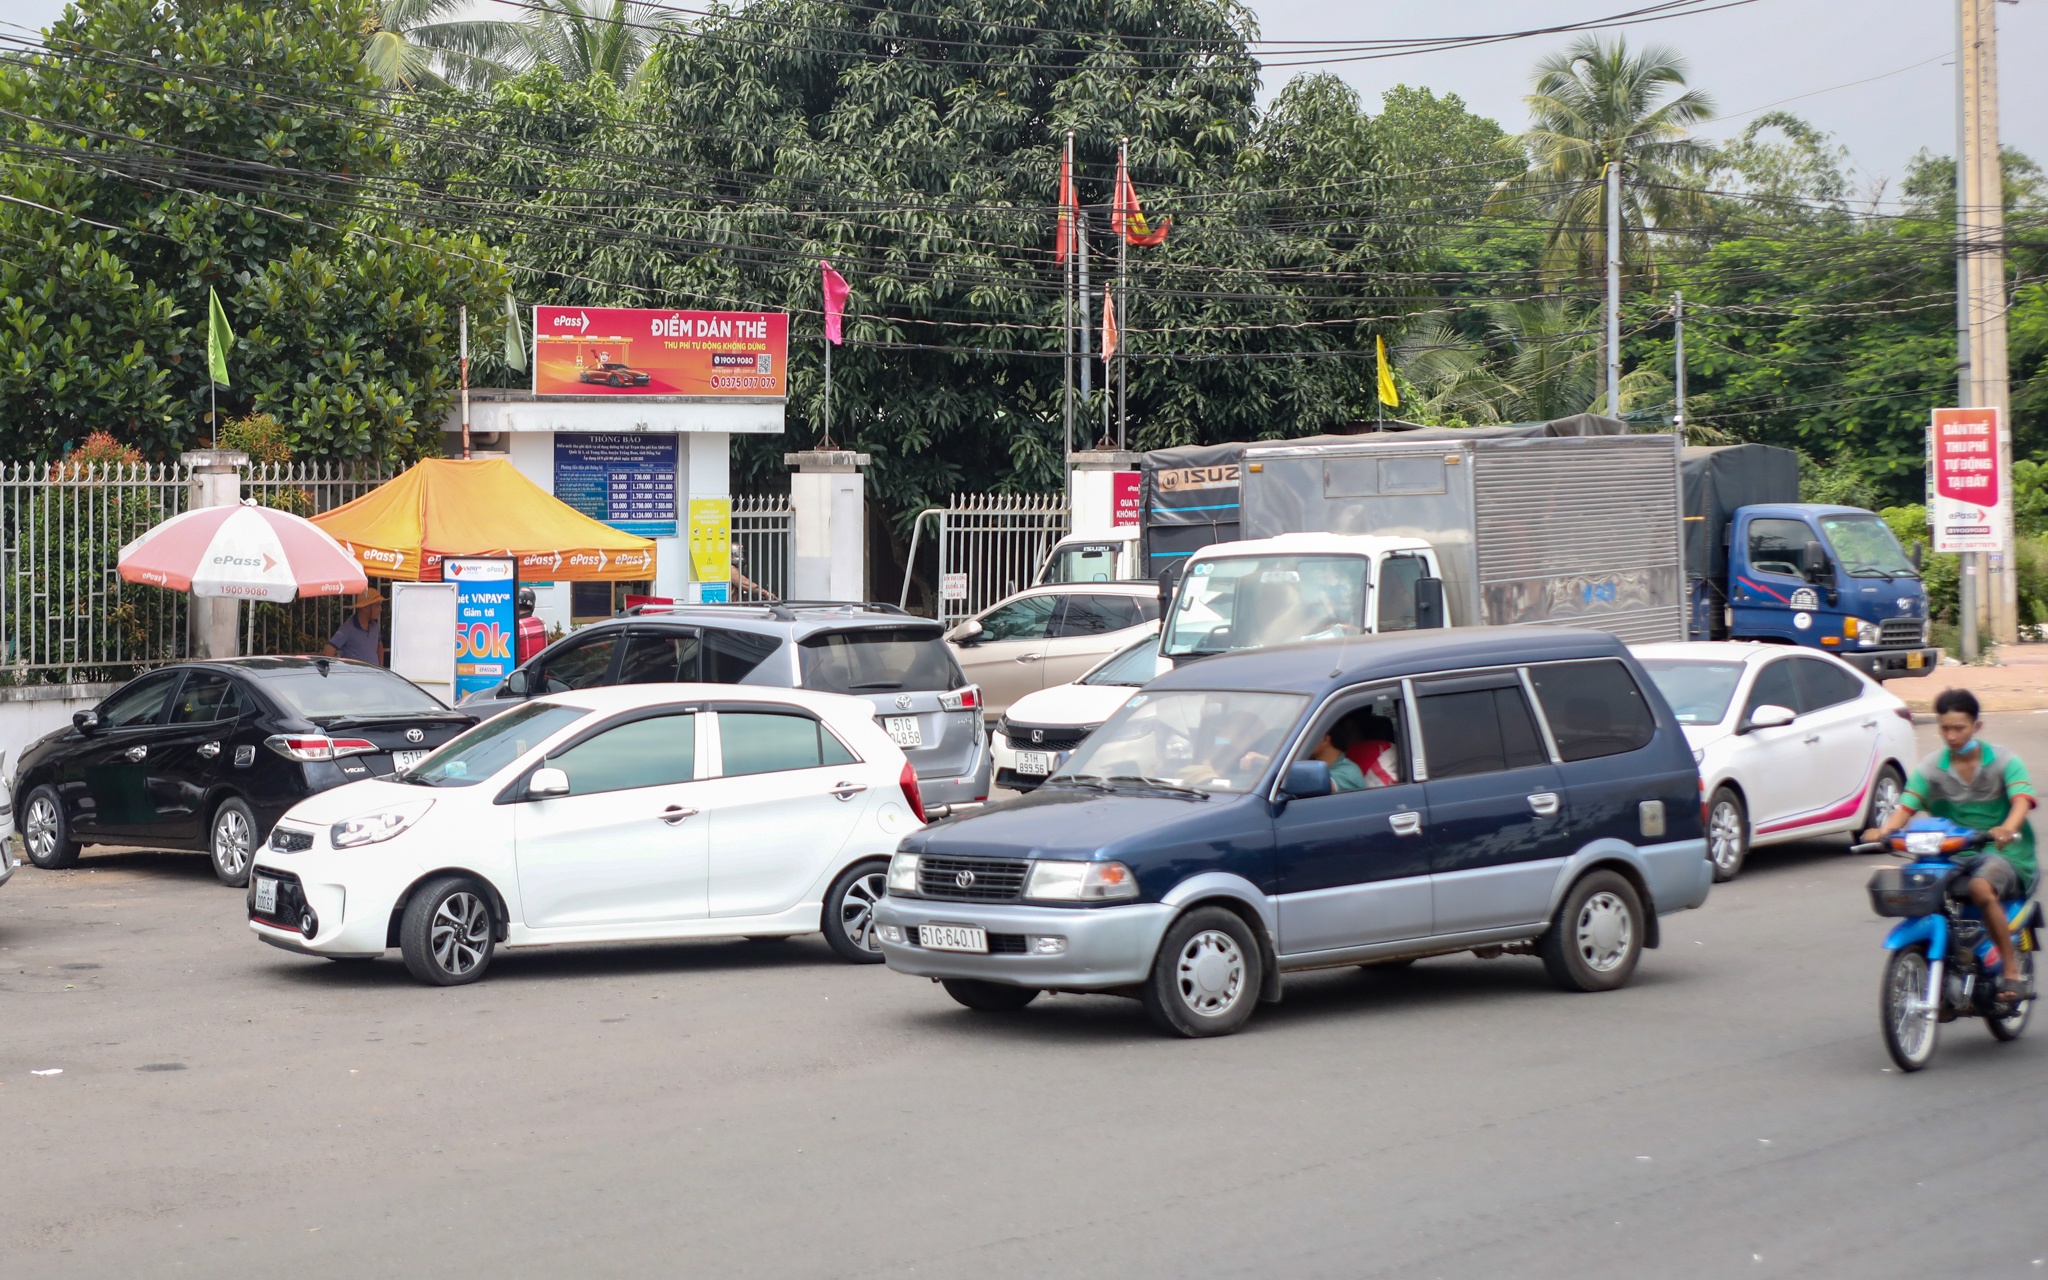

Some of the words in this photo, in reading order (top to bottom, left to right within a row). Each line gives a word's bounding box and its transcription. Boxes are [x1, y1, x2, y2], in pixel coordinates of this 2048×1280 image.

[554, 315, 582, 326] ePass
[651, 313, 692, 337] ĐIỂM
[697, 316, 731, 338] DÁN
[736, 316, 767, 338] THẺ
[679, 341, 690, 349] PHÍ
[692, 341, 701, 350] TỰ
[702, 341, 721, 350] ĐỘNG
[723, 341, 746, 350] KHÔNG
[721, 377, 740, 388] 0375
[744, 377, 758, 388] 077
[760, 377, 776, 388] 079
[589, 434, 620, 442] THÔNG
[622, 434, 641, 442] BÁO
[1184, 466, 1240, 484] ISUZ
[1120, 499, 1133, 507] QUA
[1116, 509, 1136, 518] KHÔNG
[213, 556, 261, 566] ePass
[364, 549, 395, 562] ePass
[524, 554, 554, 566] ePass
[570, 553, 599, 565] ePass
[615, 553, 643, 565] ePass
[142, 572, 162, 581] ePass
[220, 586, 242, 594] 1900
[245, 587, 268, 596] 9080
[484, 608, 494, 617] tới
[456, 622, 511, 658] 50k
[893, 718, 911, 732] 51G
[1024, 754, 1038, 762] 51H
[1020, 763, 1044, 773] 899.56
[257, 896, 273, 910] 000.62
[921, 927, 982, 948] 51G-640.11
